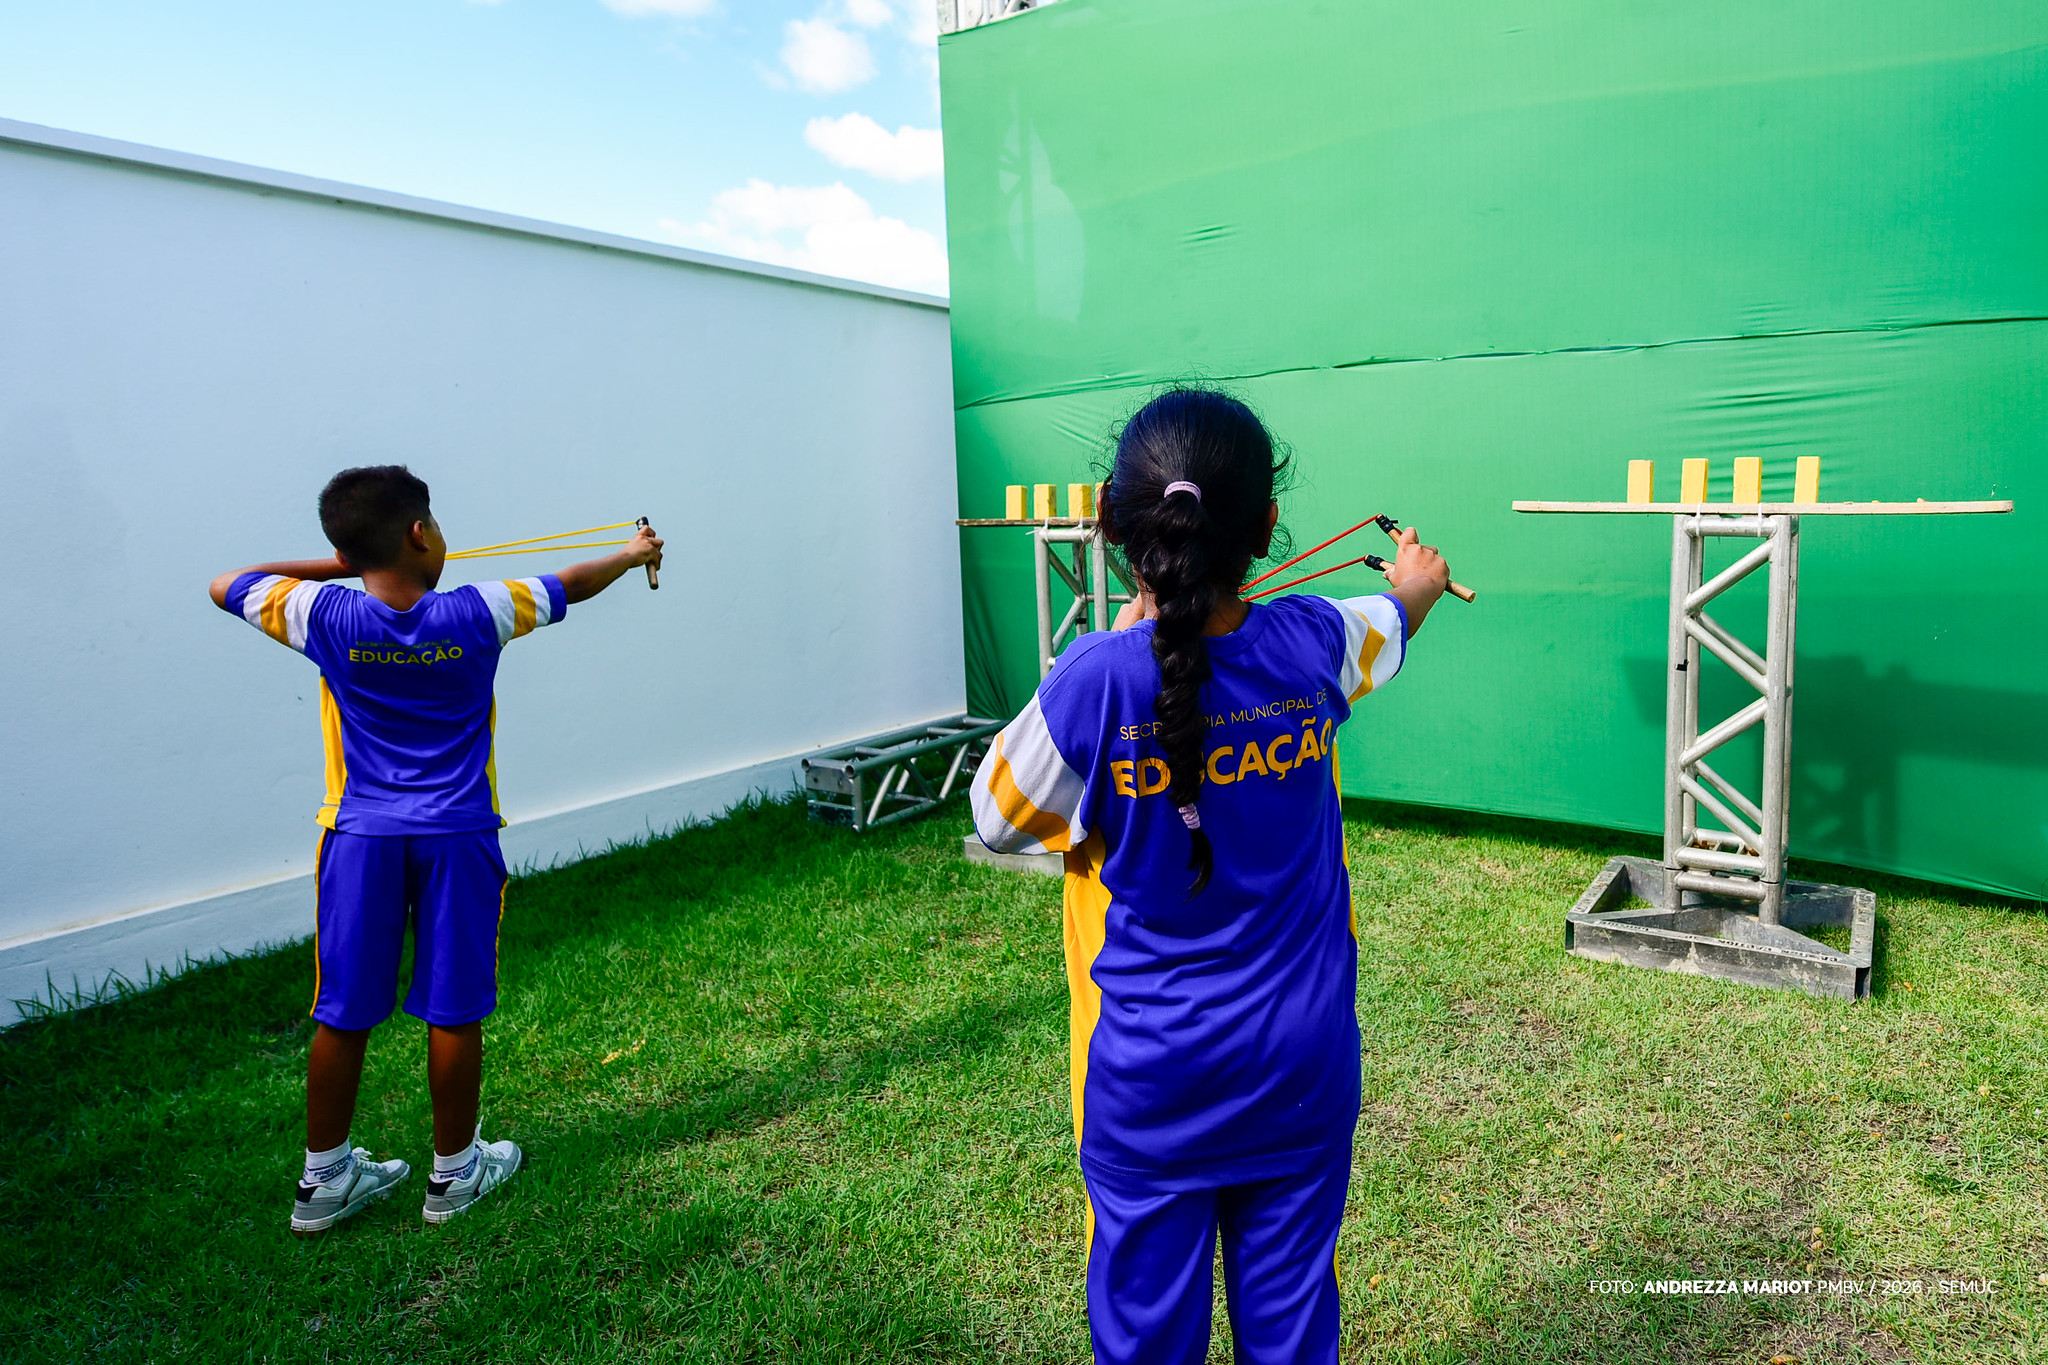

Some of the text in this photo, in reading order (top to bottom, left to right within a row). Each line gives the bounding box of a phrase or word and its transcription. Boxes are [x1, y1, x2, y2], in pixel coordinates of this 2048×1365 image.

[349, 646, 463, 666] EDUCAÇÃO
[1119, 714, 1226, 741] SECRRIA
[1230, 696, 1315, 724] MUNICIPAL
[1110, 716, 1333, 799] EDCAÇÃO
